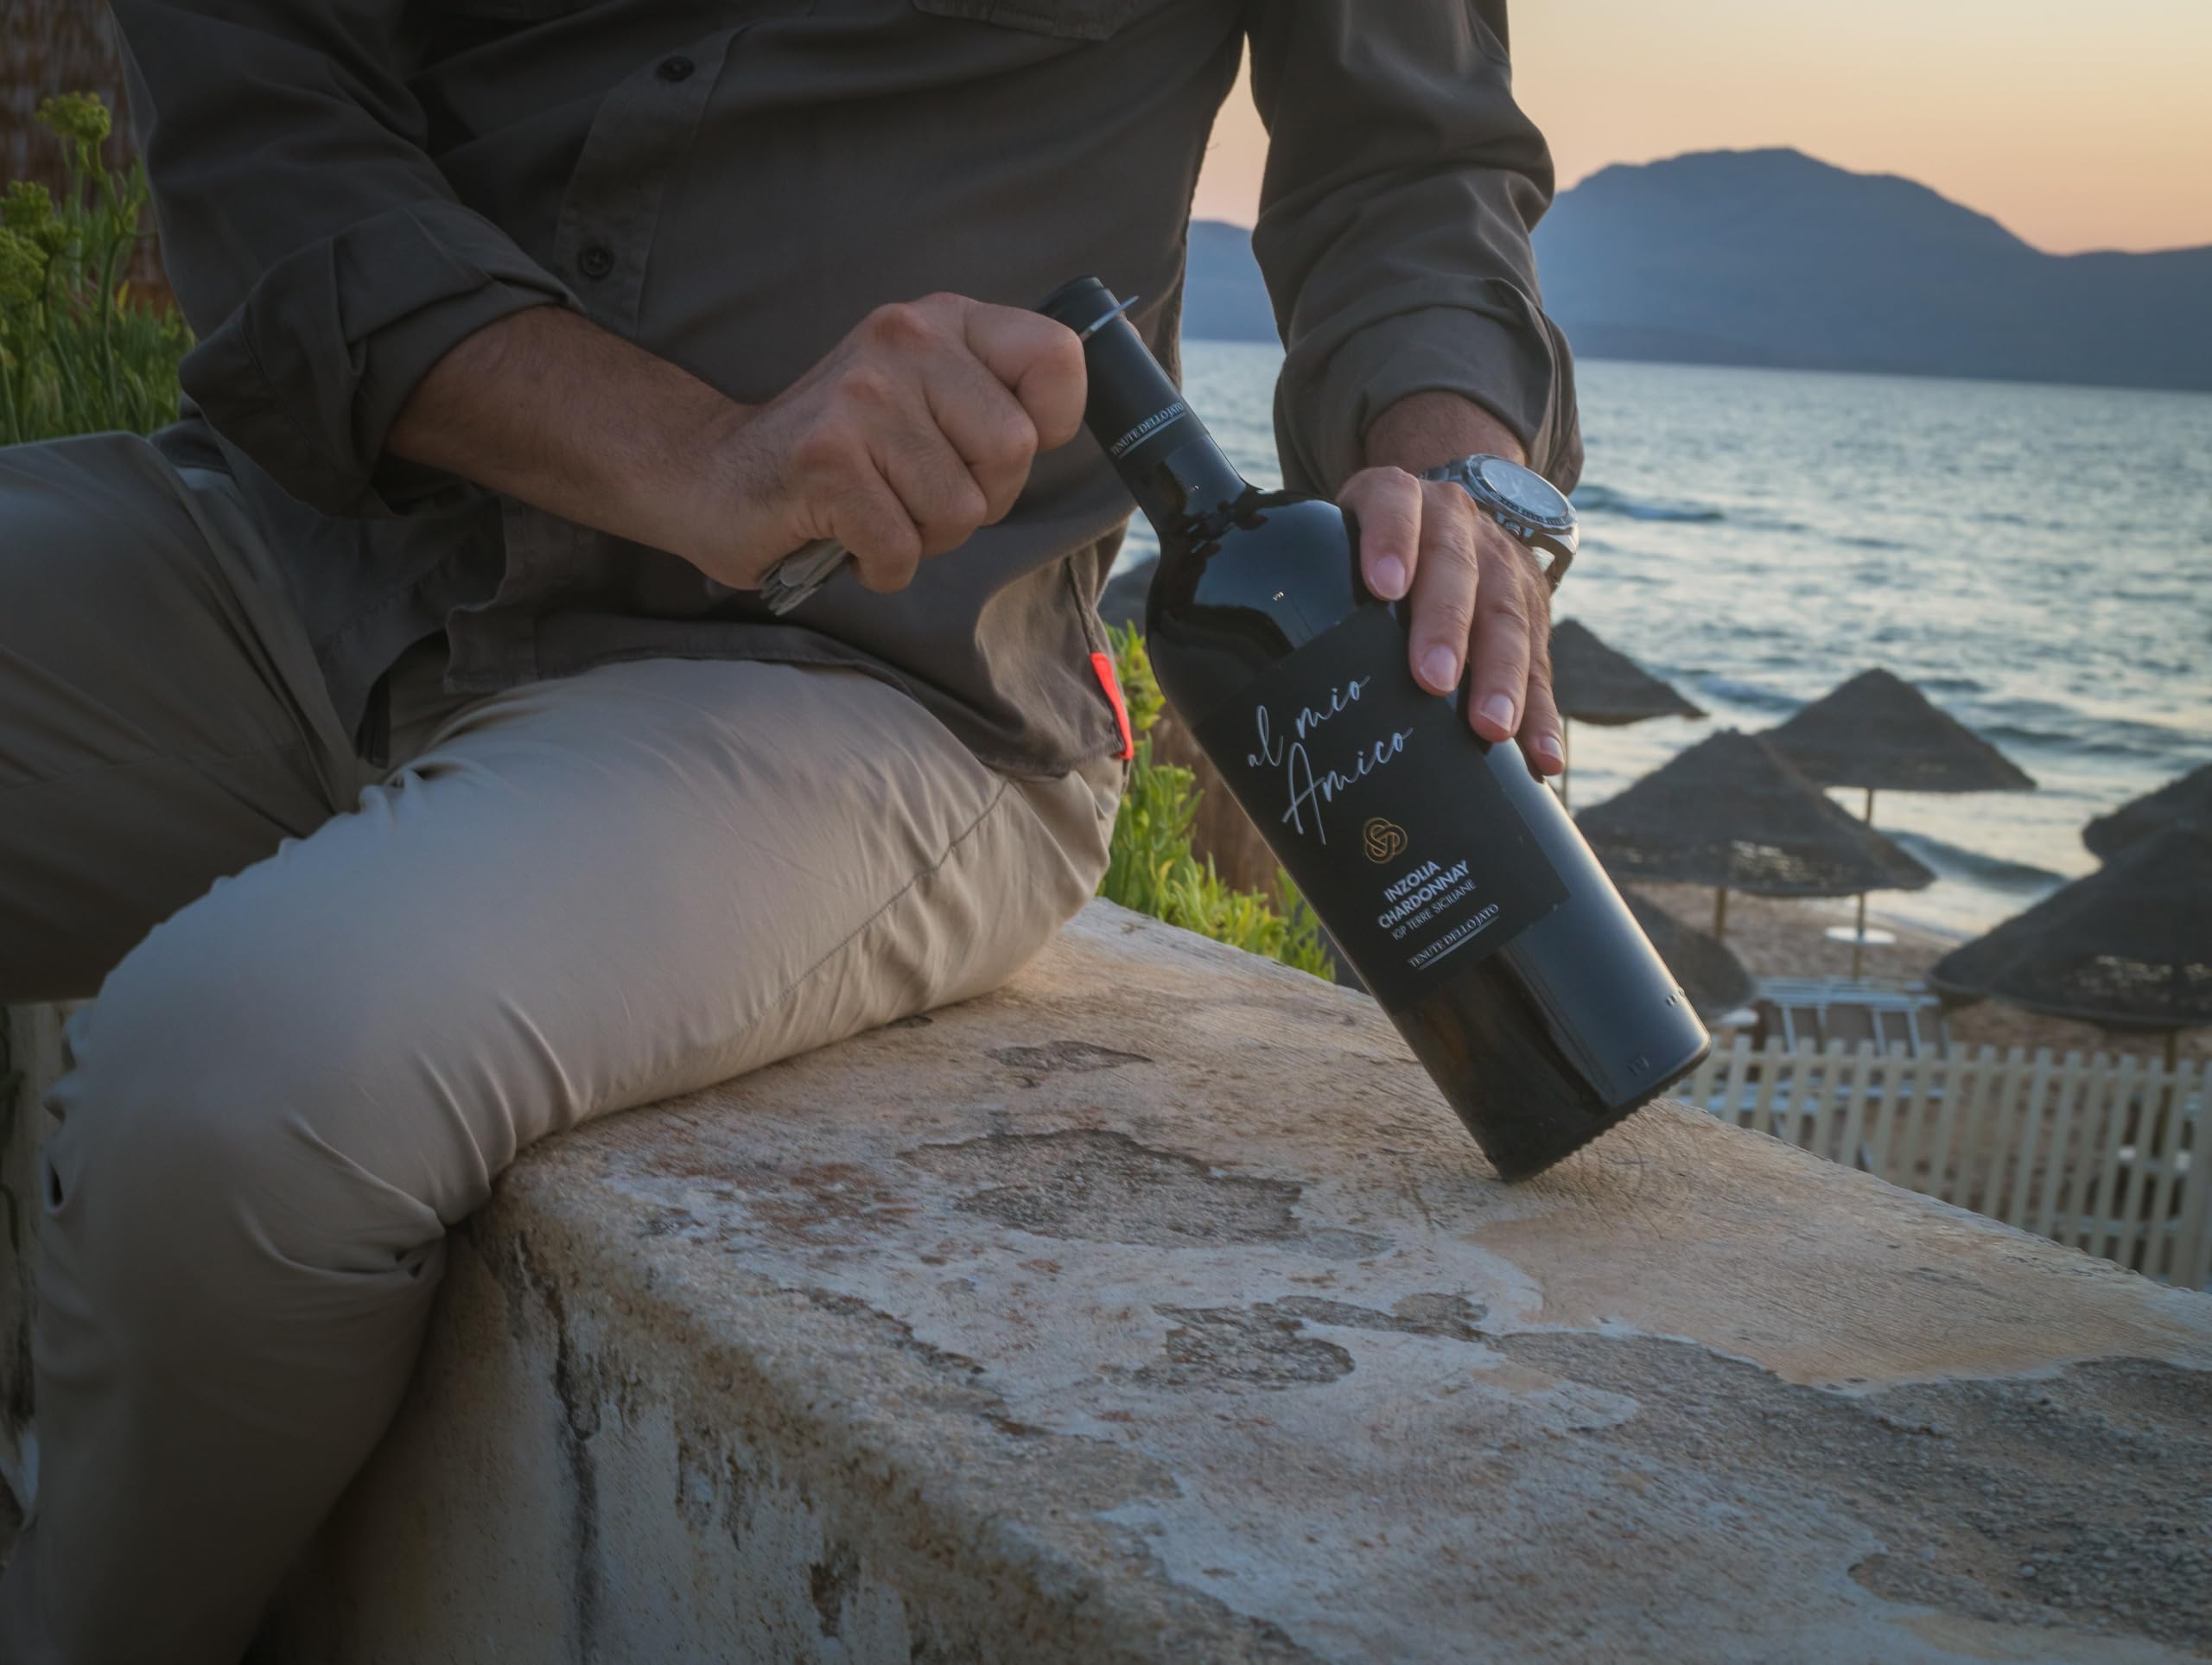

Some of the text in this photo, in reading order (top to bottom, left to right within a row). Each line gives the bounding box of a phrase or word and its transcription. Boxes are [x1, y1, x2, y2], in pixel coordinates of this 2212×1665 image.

[1110, 425, 1141, 455] TENUTE
[1248, 675, 1371, 767] al mio
[1281, 728, 1414, 846] Amico
[1377, 860, 1471, 930] CHARDONNAY
[1382, 860, 1442, 903] INZOLIA
[1407, 908, 1433, 932] TERRE
[1433, 879, 1478, 915] SICILIANE
[1408, 937, 1446, 968] TENUTE
